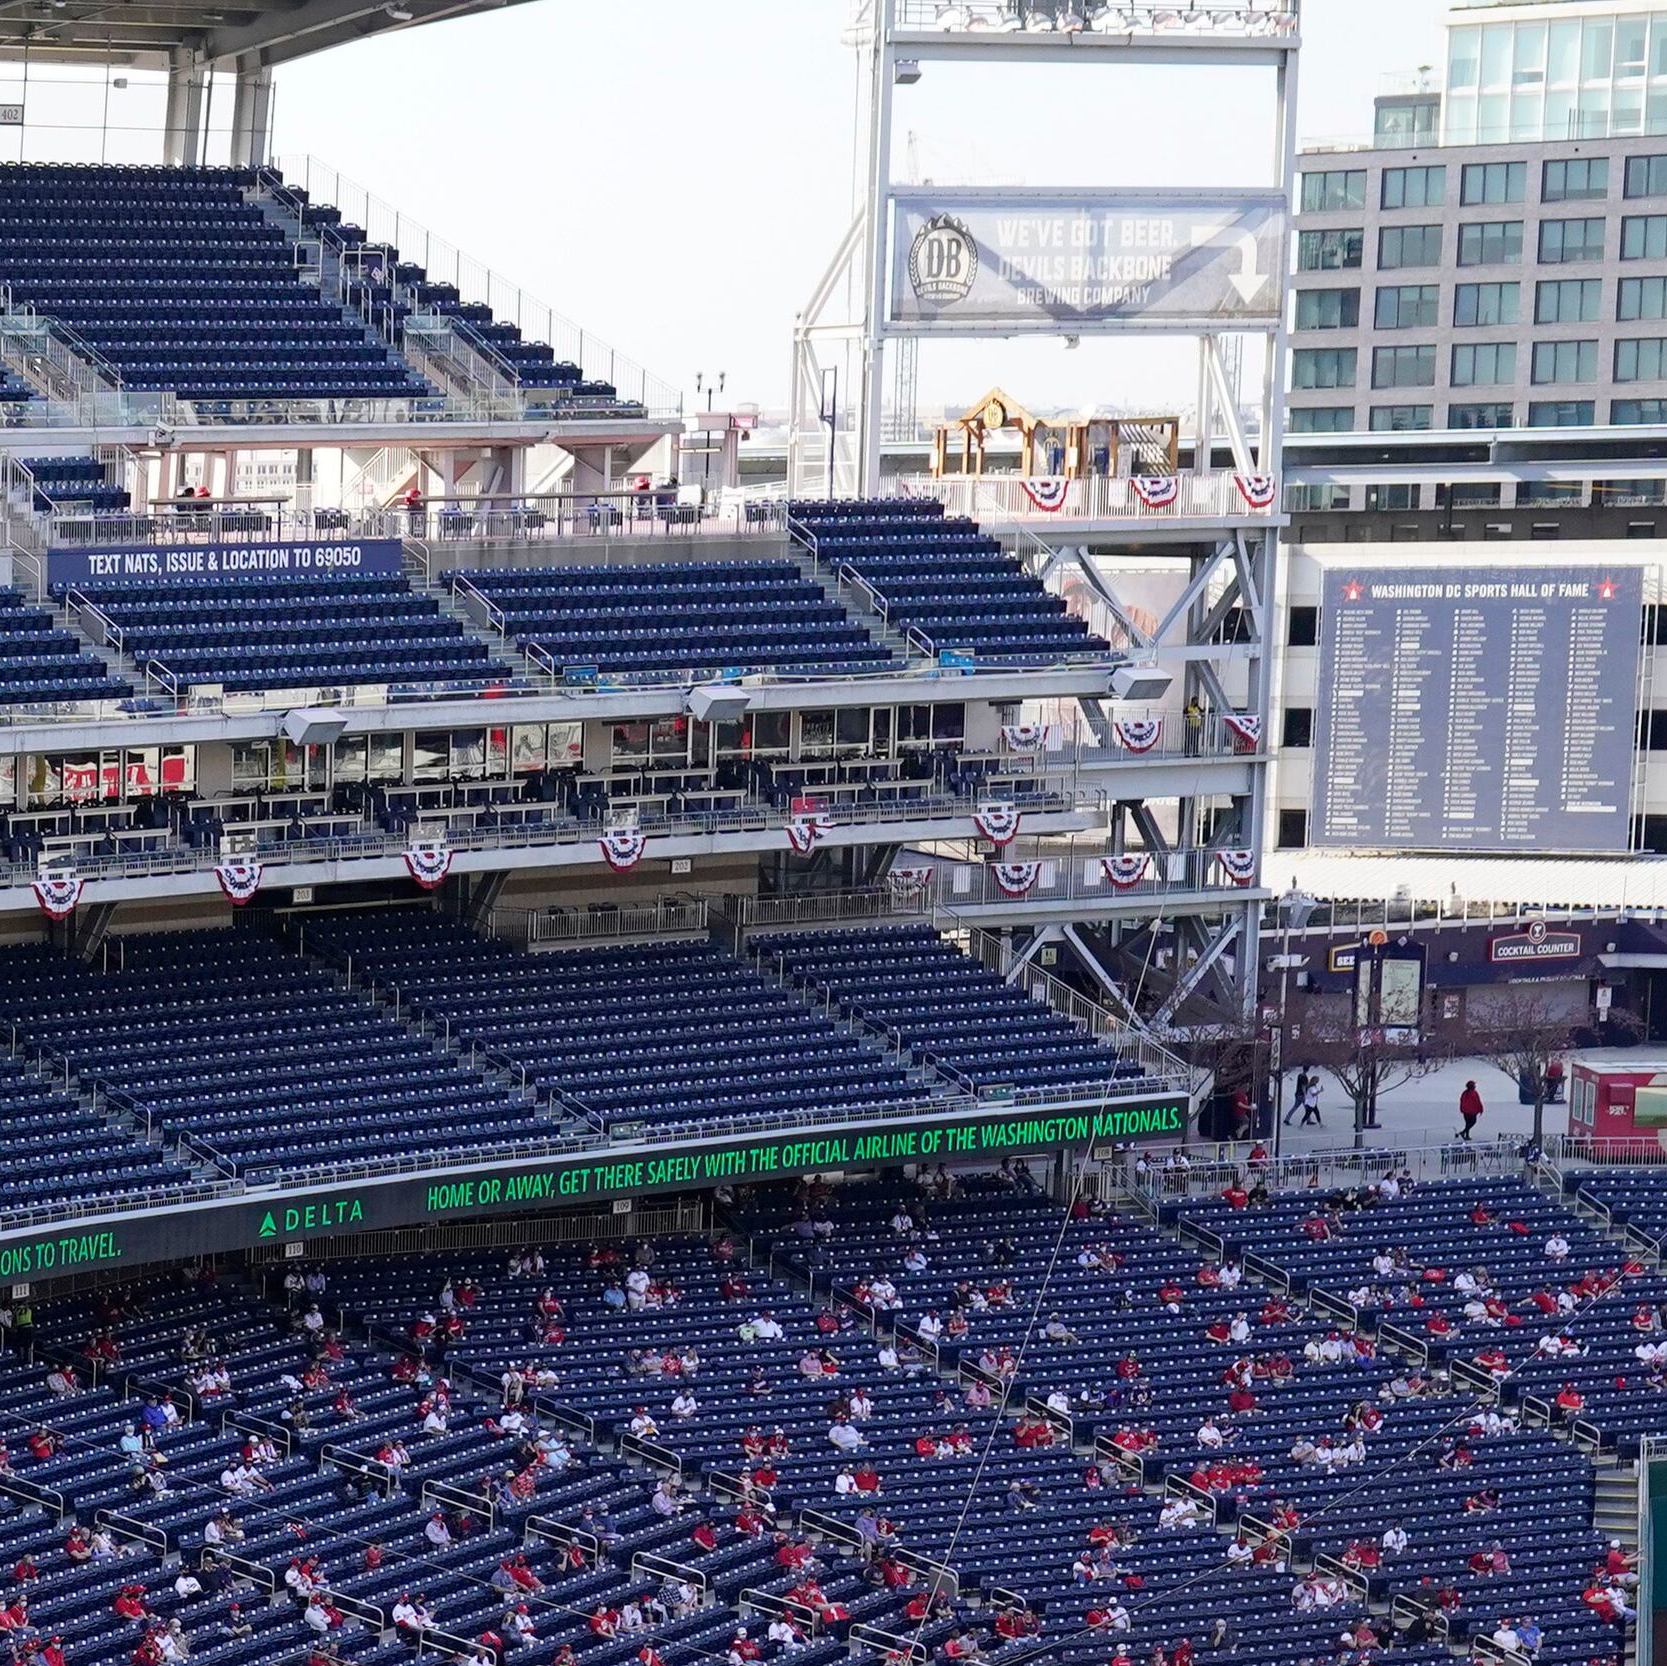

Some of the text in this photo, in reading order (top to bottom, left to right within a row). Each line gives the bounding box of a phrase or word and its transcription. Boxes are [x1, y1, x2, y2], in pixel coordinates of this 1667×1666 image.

[2, 109, 18, 120] 402
[997, 219, 1179, 247] WE'VE GOT BEER.
[927, 238, 962, 277] DB
[999, 254, 1171, 281] DEVILS BACKBONE
[1017, 286, 1151, 305] BREWING COMPANY
[89, 546, 361, 576] TEXT NATS, ISSUE & LOCATION TO 69050
[1371, 583, 1589, 599] WASHINGTON DC SPORTS HALL OF FAME
[1498, 943, 1574, 957] COCKTAIL COUNTER
[428, 1106, 1182, 1211] HOME OR AWAY, GET THERE SAFELY WITH THE OFFICIAL AIRLINE OF THE WASHINGTON NATIONALS.
[286, 1200, 363, 1232] DELTA
[616, 1201, 629, 1210] 109
[35, 1242, 55, 1270] TO
[59, 1232, 122, 1266] TRAVEL.
[287, 1244, 301, 1254] 110
[15, 1285, 27, 1297] 111
